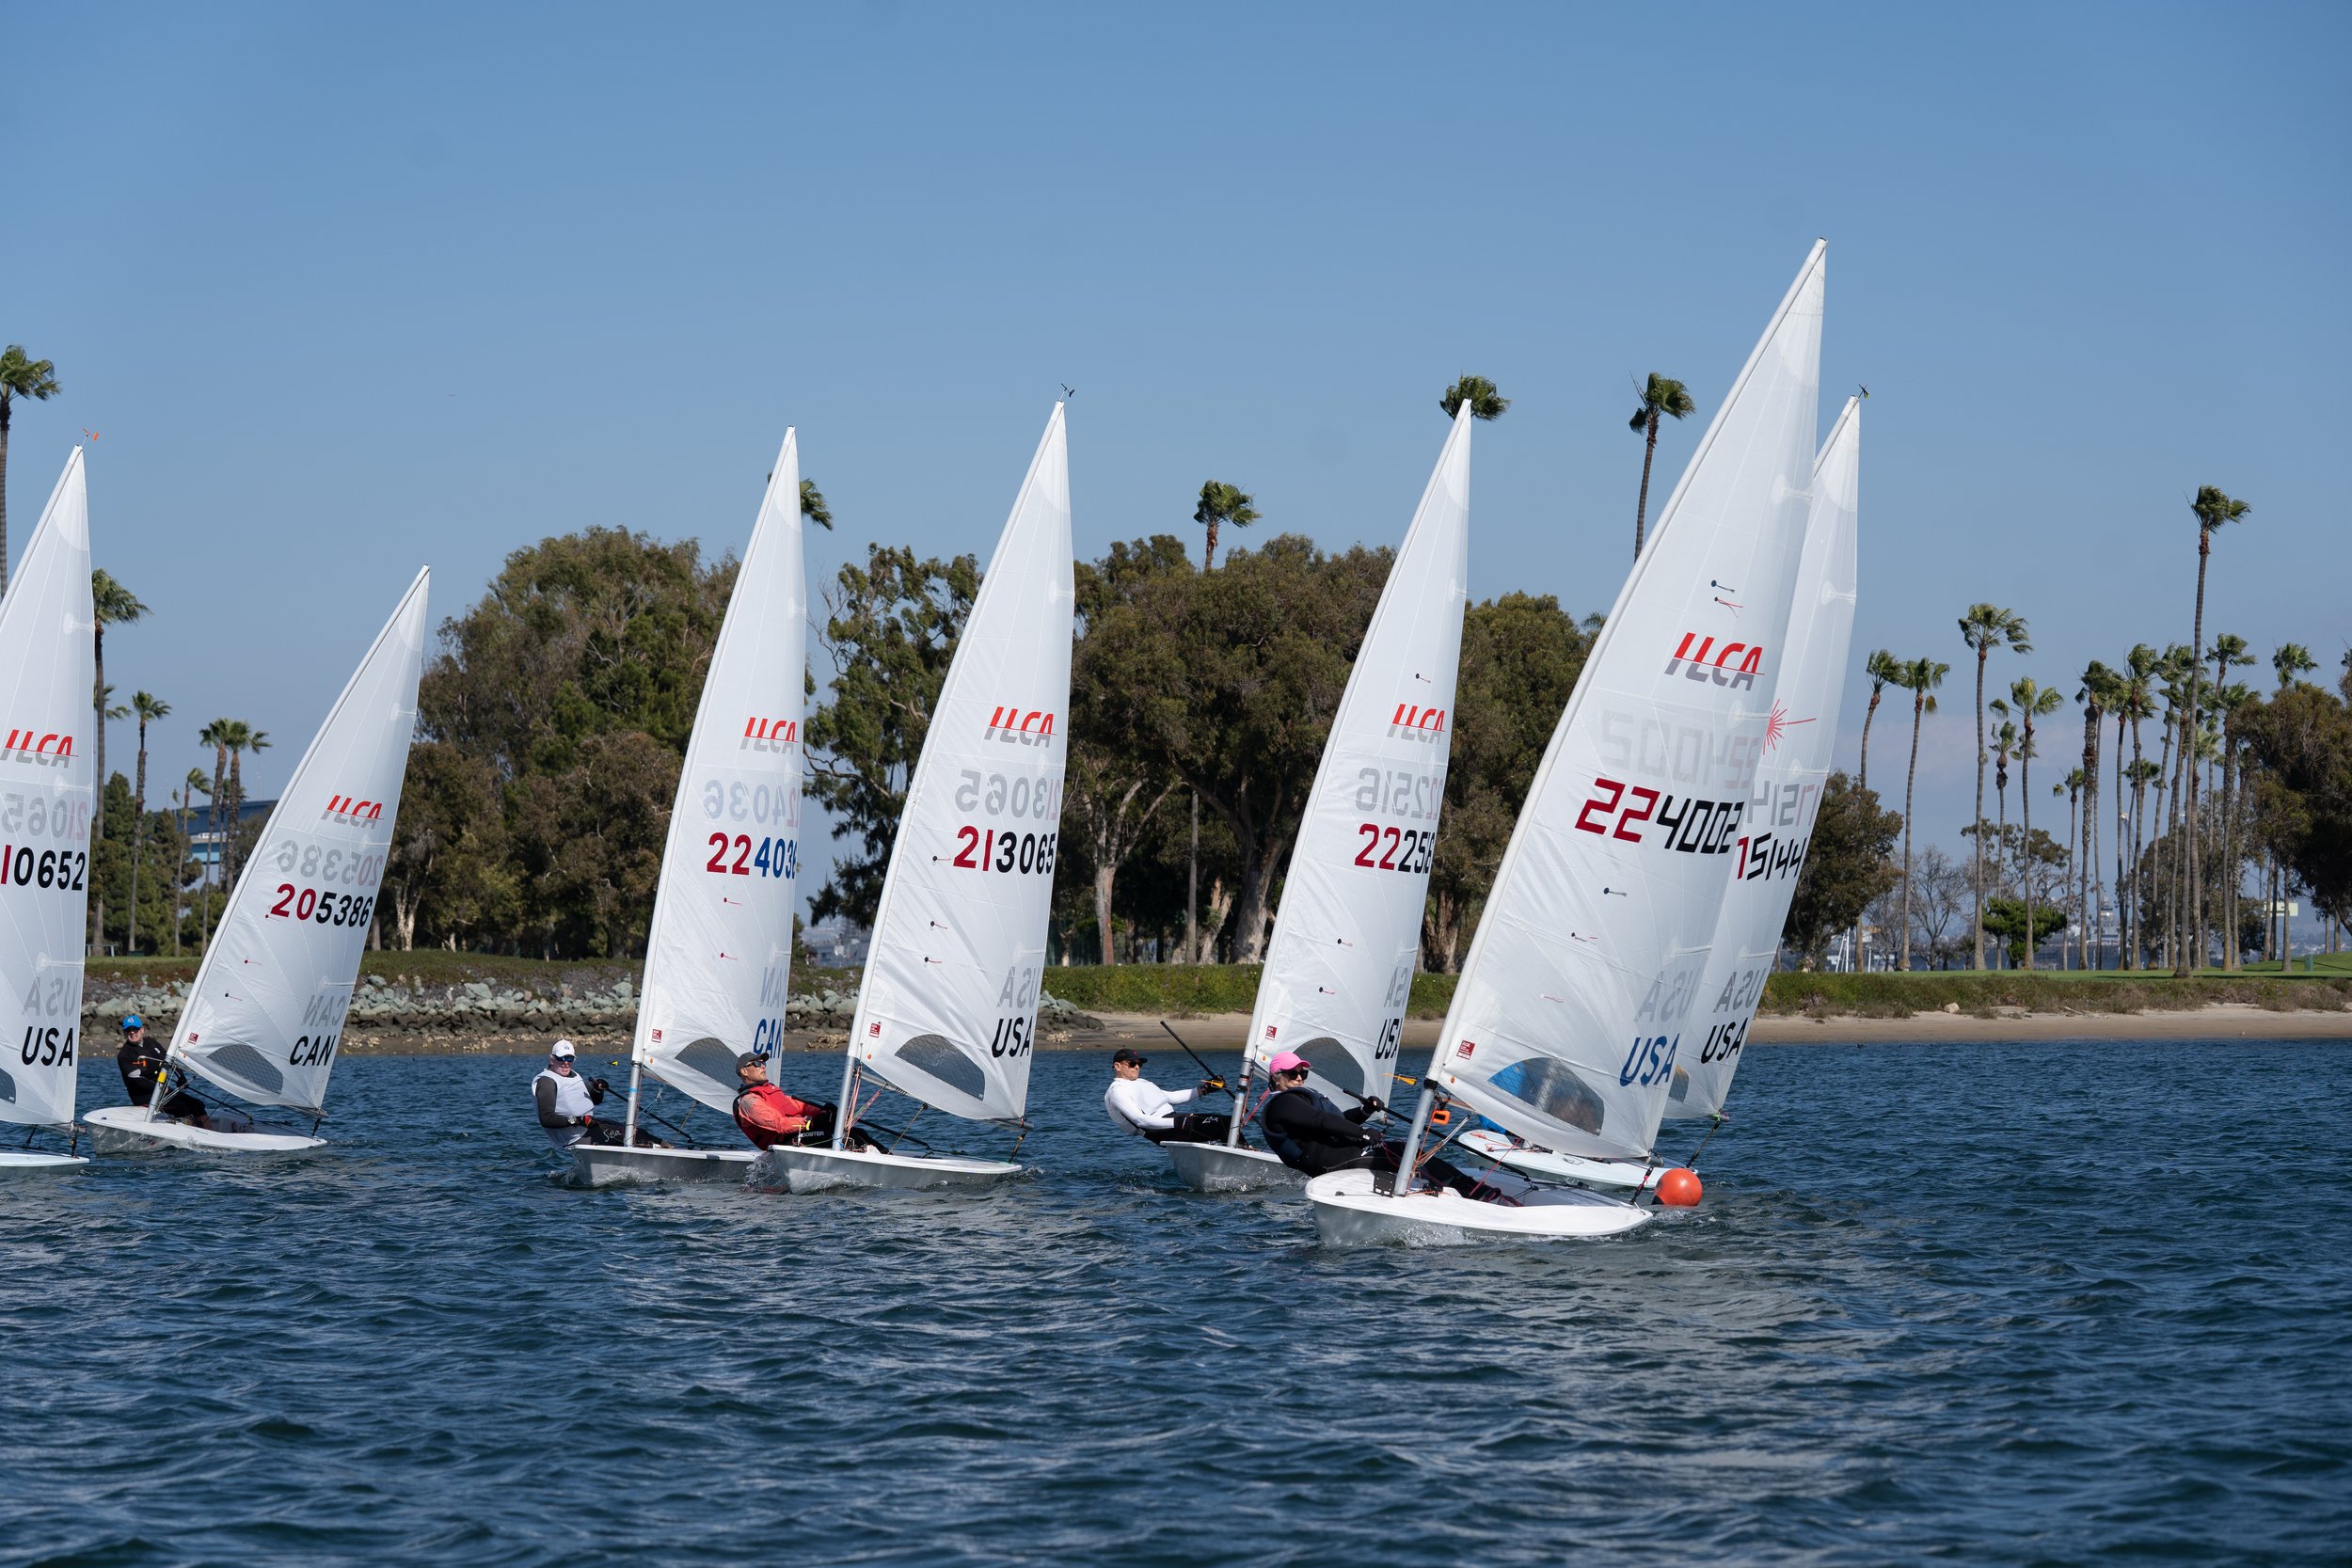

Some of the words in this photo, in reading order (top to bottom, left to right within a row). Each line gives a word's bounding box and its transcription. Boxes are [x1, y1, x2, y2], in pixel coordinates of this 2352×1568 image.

[1664, 632, 1763, 691] ILCA
[739, 717, 797, 754] ILCA
[984, 706, 1055, 748] ILCA
[1387, 704, 1445, 745] ILCA
[0, 729, 75, 768] ILCA
[321, 795, 384, 830] ILCA
[1575, 778, 1744, 854] 224002
[953, 825, 1056, 875] 213065
[270, 883, 373, 927] 205386
[22, 1026, 73, 1067] USA
[290, 1035, 336, 1066] CAN
[992, 1016, 1032, 1058] USA
[1701, 1017, 1748, 1064] USA
[1619, 1033, 1680, 1086] USA
